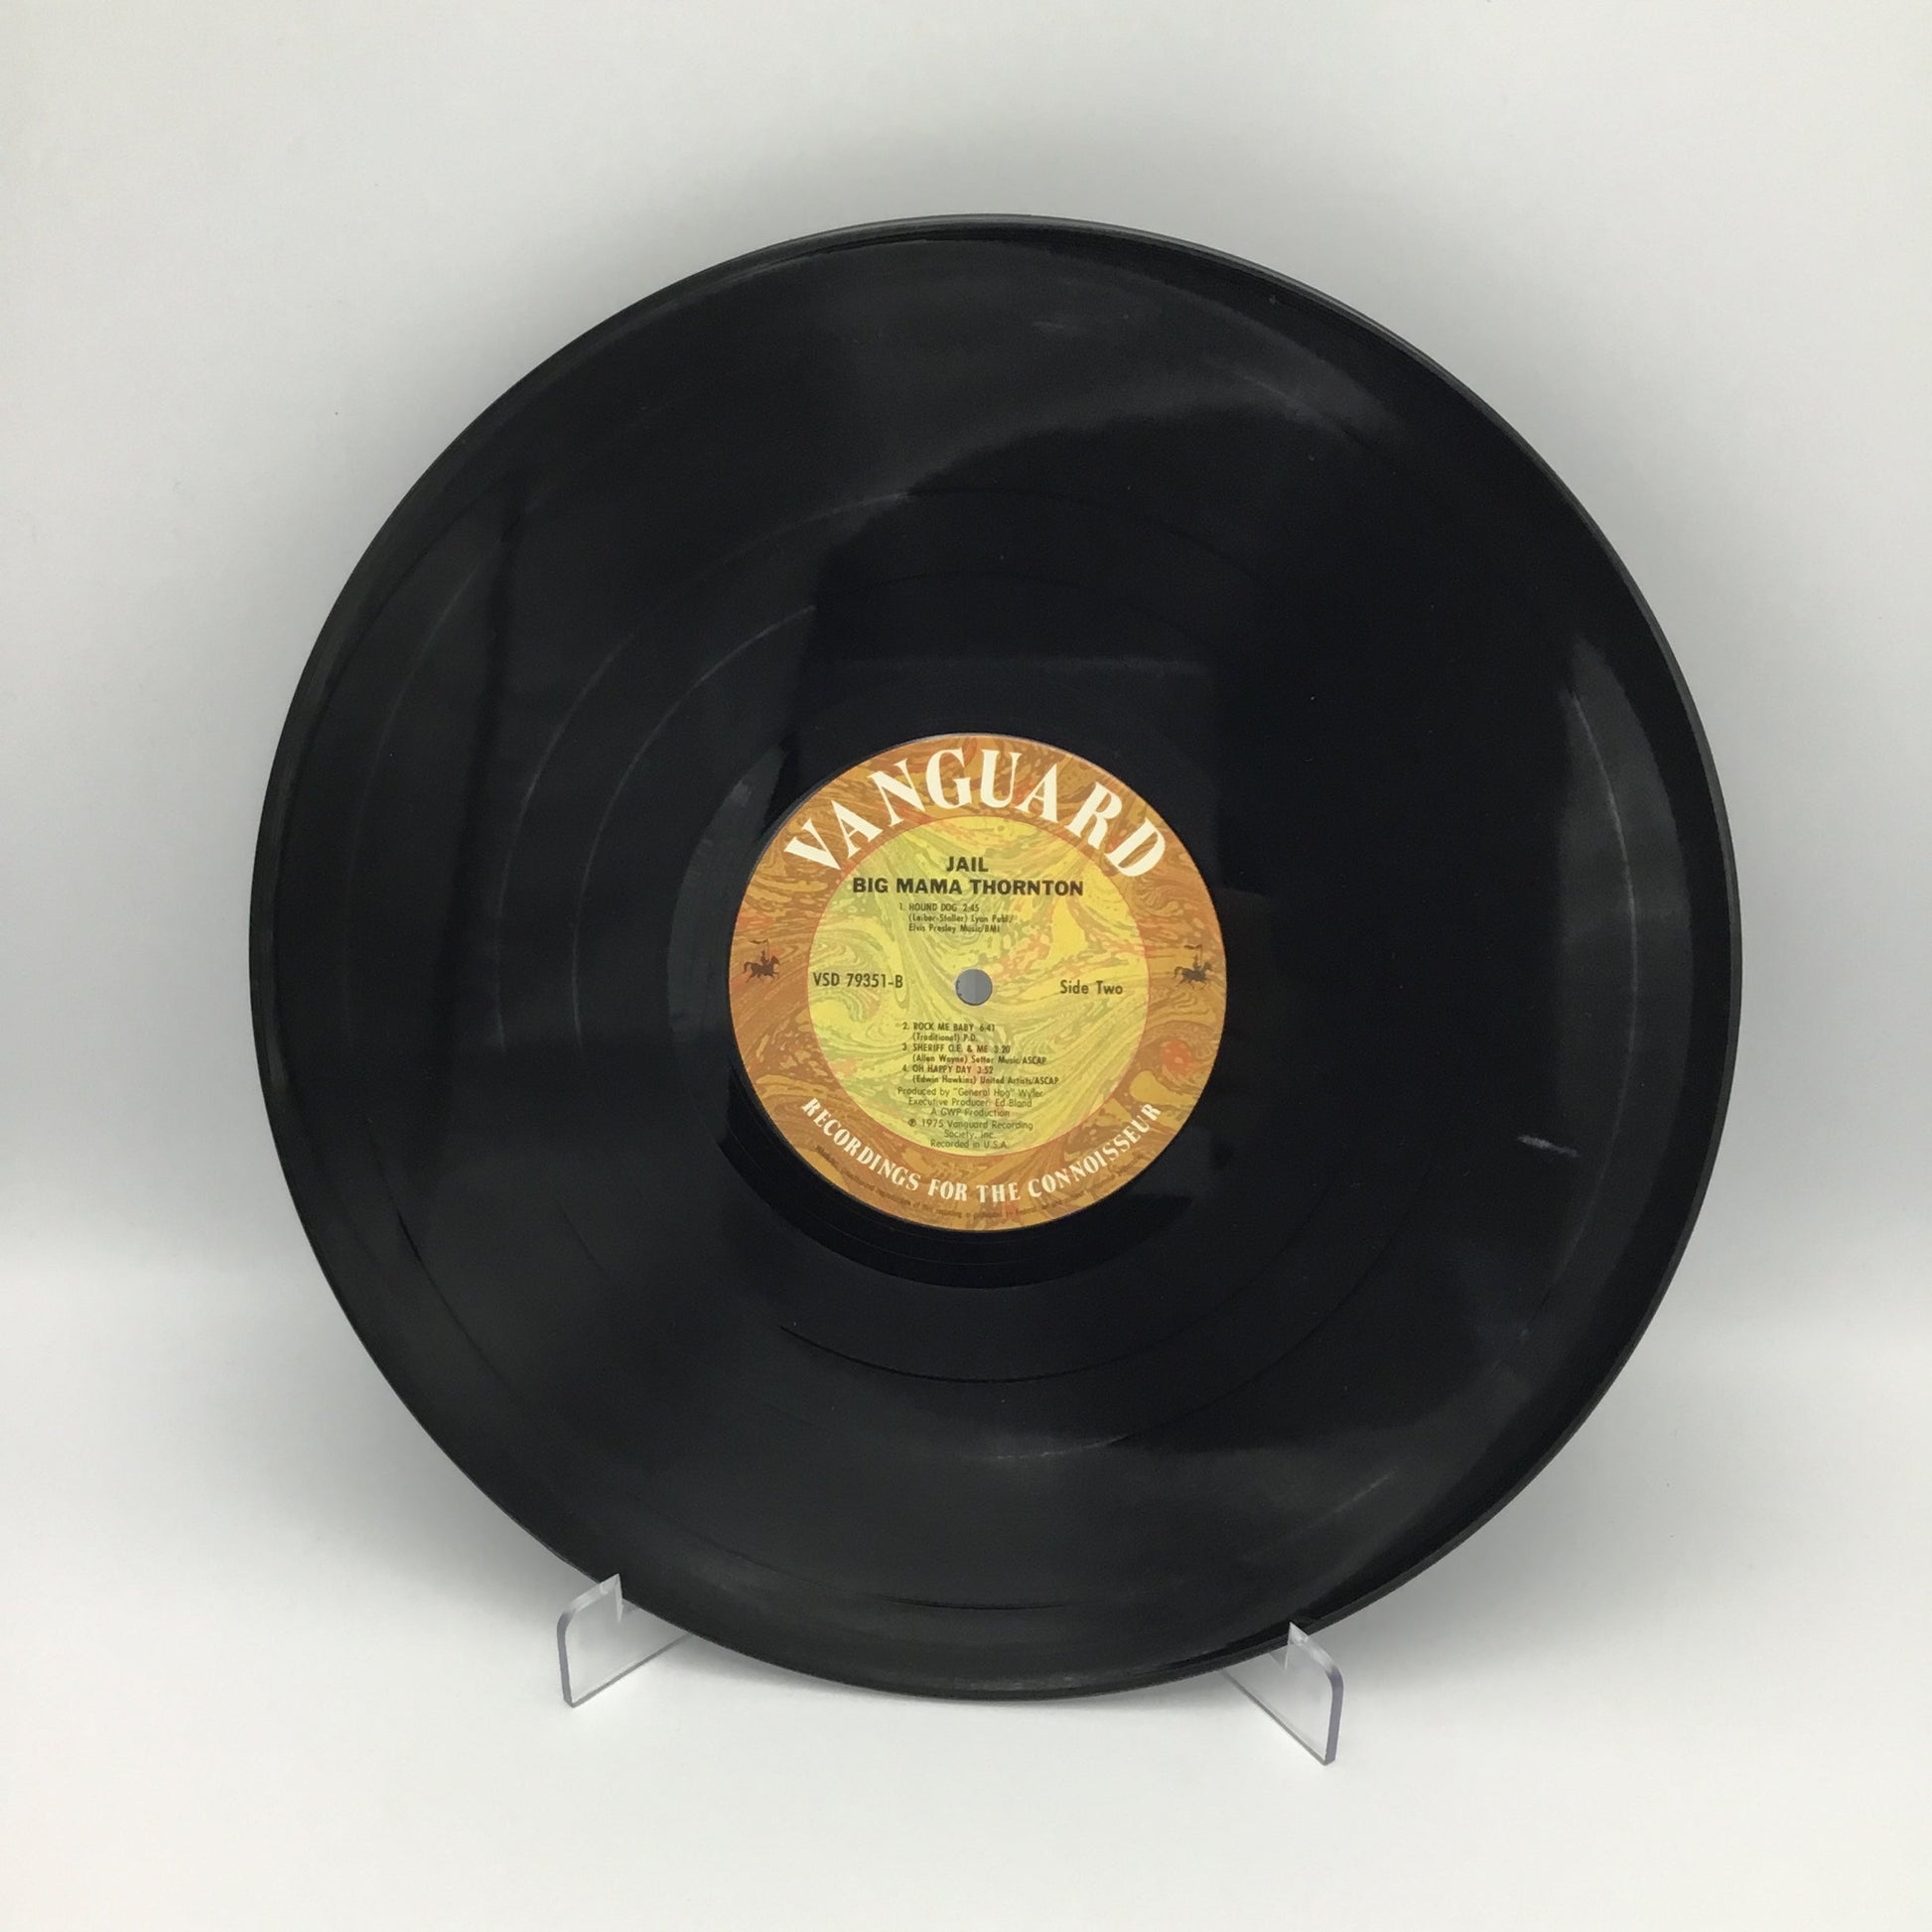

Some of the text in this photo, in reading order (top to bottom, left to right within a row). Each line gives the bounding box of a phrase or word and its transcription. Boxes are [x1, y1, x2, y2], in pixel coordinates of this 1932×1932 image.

[783, 747, 1166, 877] VANGUARD
[945, 856, 989, 872] JAIL
[852, 877, 1083, 896] BIG MAMA THORNTON
[908, 902, 938, 911] HOUND
[940, 902, 958, 912] DOG
[908, 922, 926, 932] Elvis
[928, 923, 956, 933] Presley
[812, 972, 903, 989] VSD 79351-B
[1059, 979, 1124, 995] Side Two
[937, 1023, 950, 1032] ME
[912, 1033, 961, 1041] (Traditional)
[912, 1043, 945, 1052] SHERIFF
[976, 1044, 989, 1053] ME
[994, 1044, 1011, 1053] 3:20
[938, 1054, 968, 1064] Wayne)
[997, 1055, 1047, 1064] Music/ASCAP
[912, 1064, 924, 1073] OH
[927, 1065, 952, 1074] HAPPY
[955, 1065, 972, 1074] DAY
[912, 1075, 939, 1084] (Edwin
[941, 1075, 977, 1085] Hawkins)
[1007, 1076, 1059, 1086] Artists/ASCAP
[897, 1087, 937, 1096] Produced
[939, 1087, 950, 1097] by
[952, 1087, 990, 1097] "General
[908, 1097, 949, 1106] Executive
[995, 1098, 1006, 1107] Ed
[1009, 1099, 1033, 1108] Bland
[930, 1107, 1011, 1117] A GWP Production
[921, 1119, 944, 1128] 1975
[946, 1120, 988, 1129] Vanguard
[991, 1120, 1034, 1131] Recording
[800, 1097, 921, 1191] RECORDINGS
[927, 1177, 968, 1202] FOR
[976, 1183, 1020, 1203] THE
[1027, 1102, 1162, 1199] CONNOISSEUR
[929, 1140, 970, 1149] Recorded
